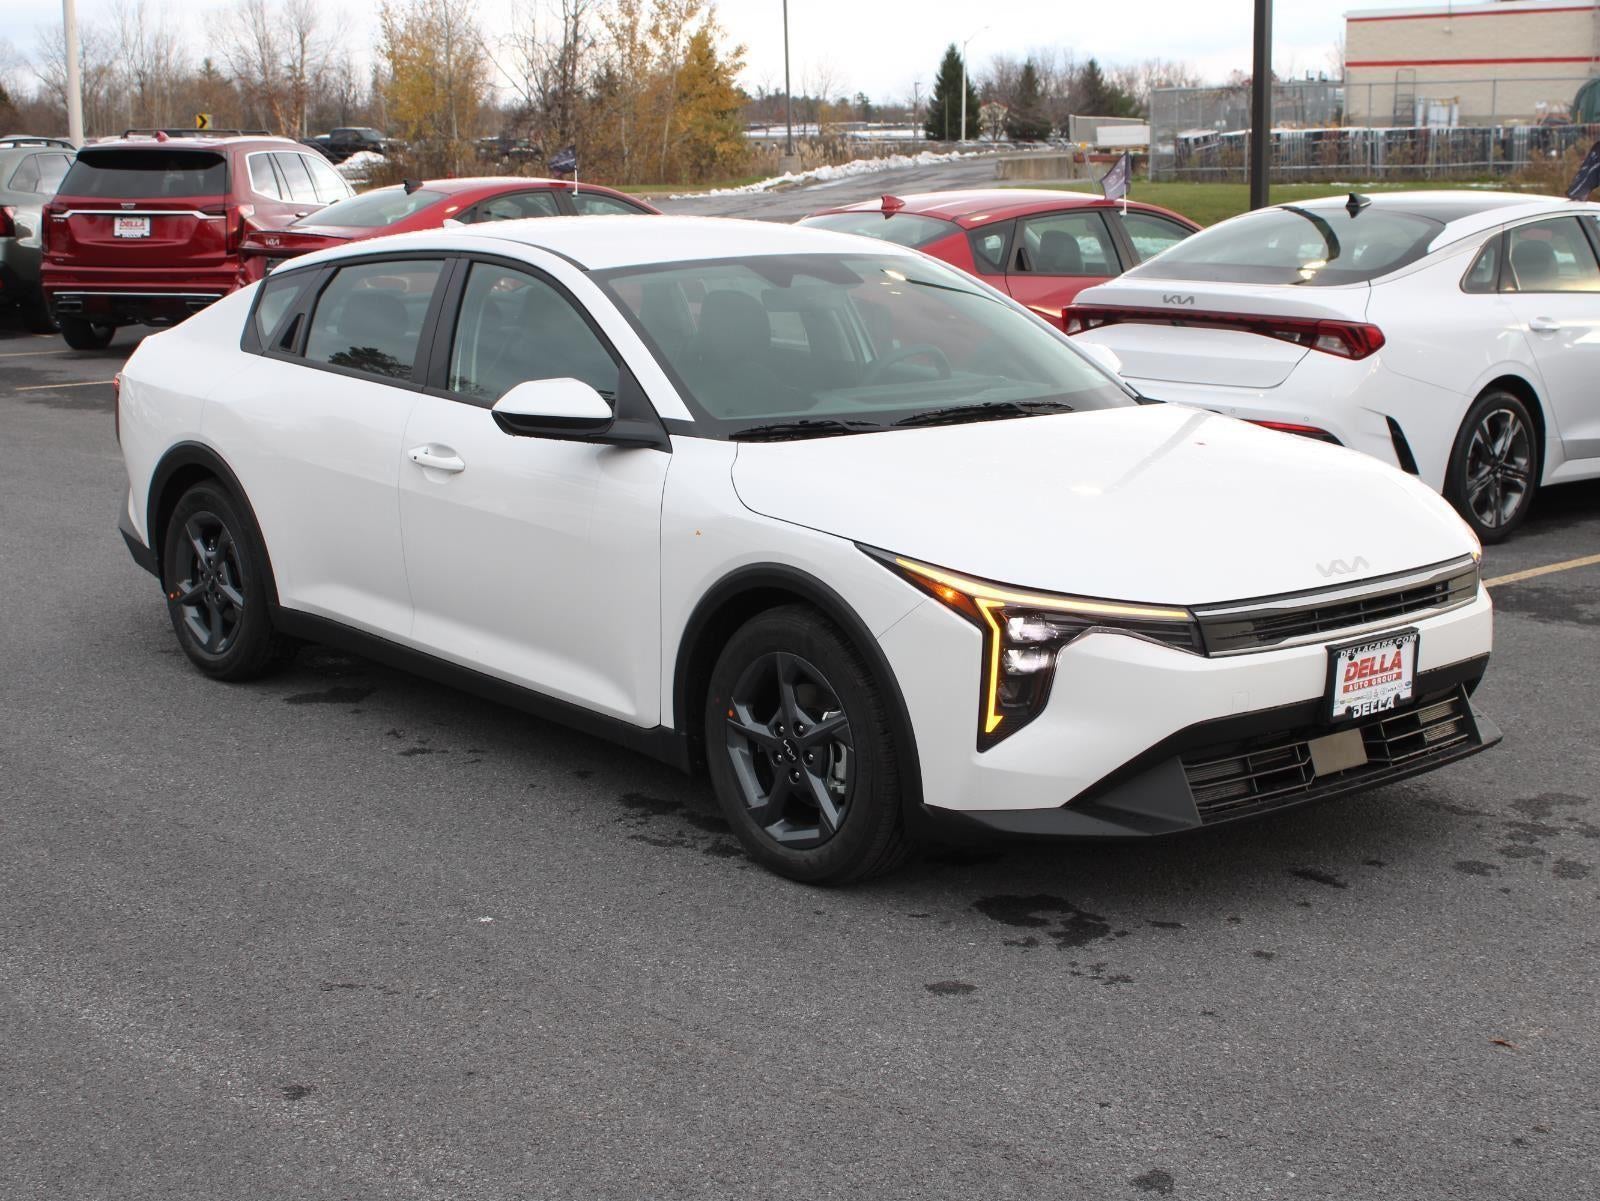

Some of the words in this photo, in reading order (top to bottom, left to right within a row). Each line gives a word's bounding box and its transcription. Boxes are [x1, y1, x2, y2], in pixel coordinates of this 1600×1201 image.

[1162, 294, 1195, 305] KIA
[1315, 555, 1370, 577] KIA
[1340, 634, 1417, 658] DELLACARS.COM
[1344, 650, 1402, 683] DELLA
[1348, 681, 1369, 692] AUTO
[1371, 673, 1397, 686] GROUP
[1352, 696, 1395, 718] DELLA
